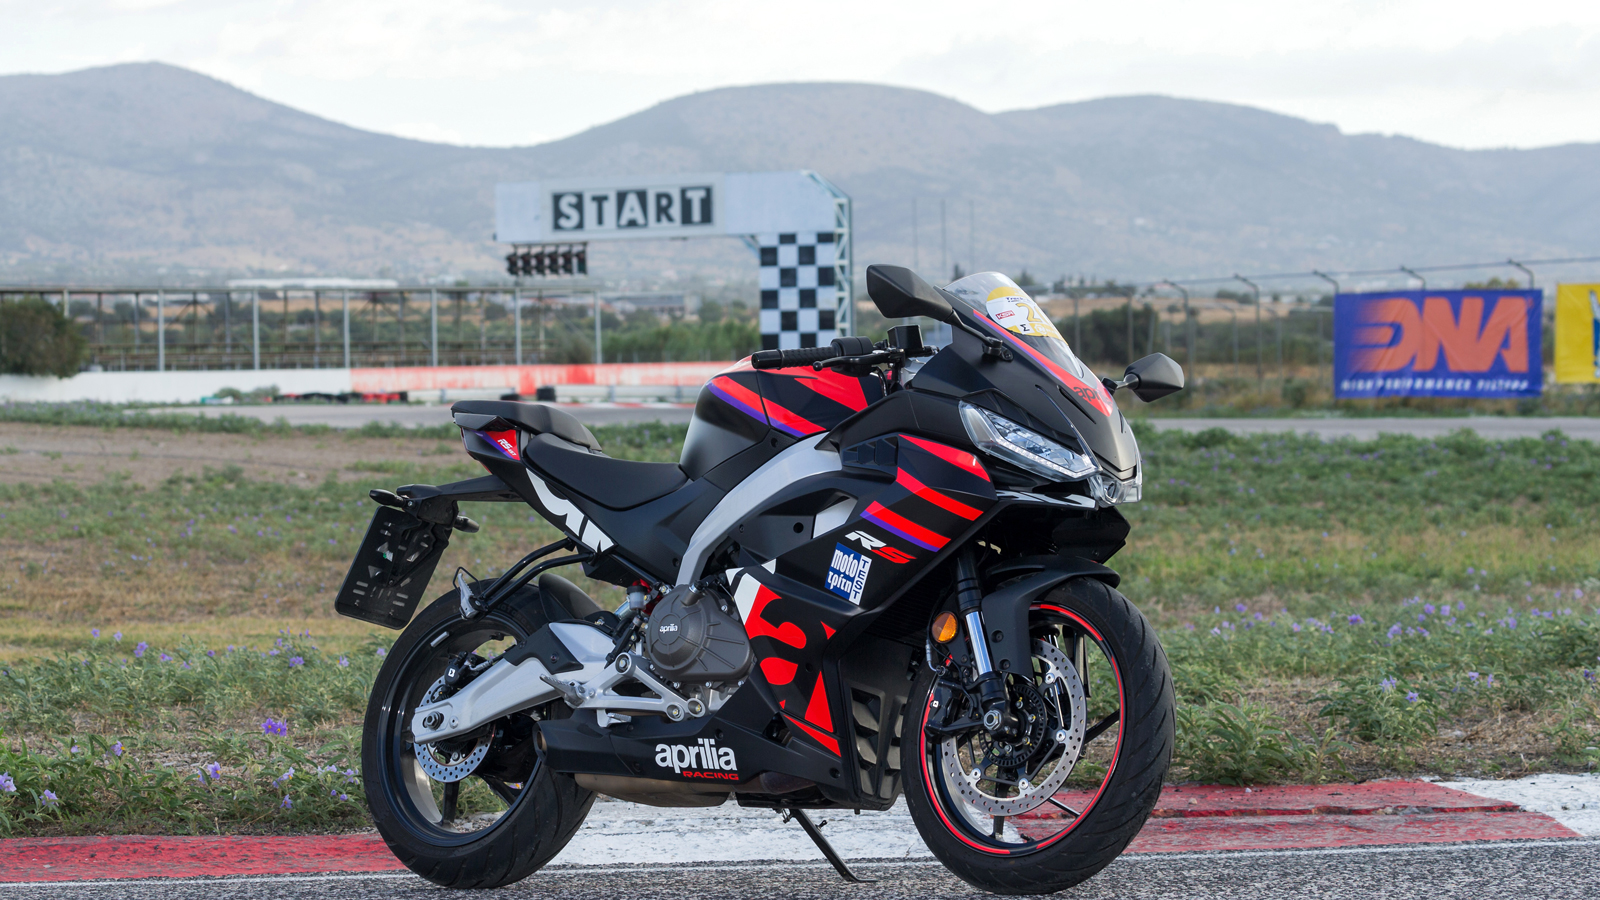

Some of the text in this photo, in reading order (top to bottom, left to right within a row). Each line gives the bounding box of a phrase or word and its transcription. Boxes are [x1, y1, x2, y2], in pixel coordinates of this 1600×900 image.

[556, 188, 708, 230] START
[1347, 297, 1529, 373] DNA
[831, 549, 858, 577] moto
[845, 530, 917, 564] RS
[852, 559, 869, 600] TEST
[655, 738, 737, 773] aprilia
[682, 771, 739, 780] RACING
